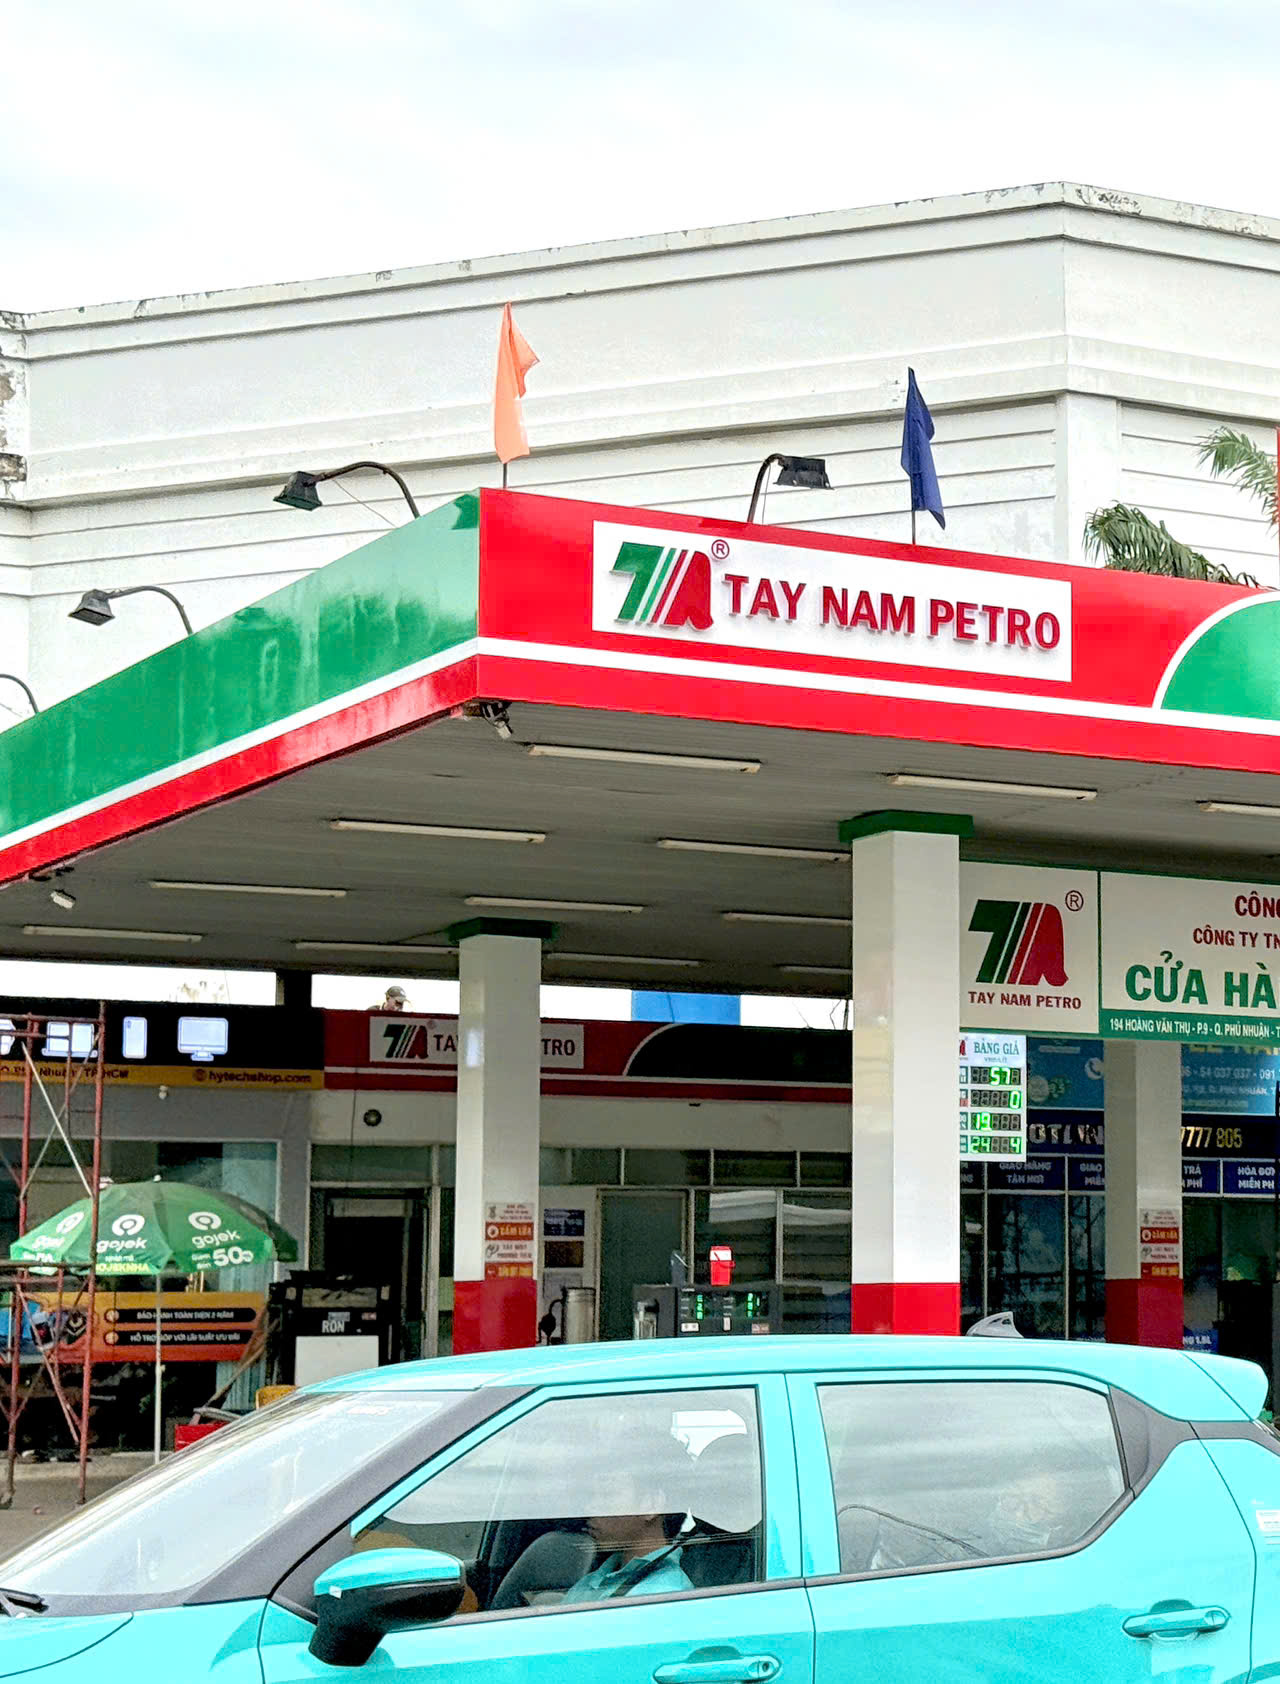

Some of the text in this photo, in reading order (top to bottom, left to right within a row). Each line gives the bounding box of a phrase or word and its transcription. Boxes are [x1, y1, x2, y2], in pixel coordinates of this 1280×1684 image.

[723, 573, 1061, 650] TAY NAM PETRO
[1193, 924, 1235, 947] CÔNG
[1239, 931, 1259, 948] TY
[1125, 950, 1209, 1005] CỬA
[968, 991, 1081, 1009] TAY NAM PETRO
[1110, 1018, 1123, 1031] 194
[1125, 1018, 1154, 1032] HOÀNG
[1156, 1017, 1173, 1033] VĂN
[1174, 1021, 1191, 1037] THỤ
[433, 1034, 459, 1052] TA
[541, 1038, 575, 1056] TRO
[1003, 1040, 1019, 1055] GIÁ
[96, 1236, 148, 1253] gojek
[191, 1229, 241, 1249] gojek
[322, 1320, 345, 1333] RON
